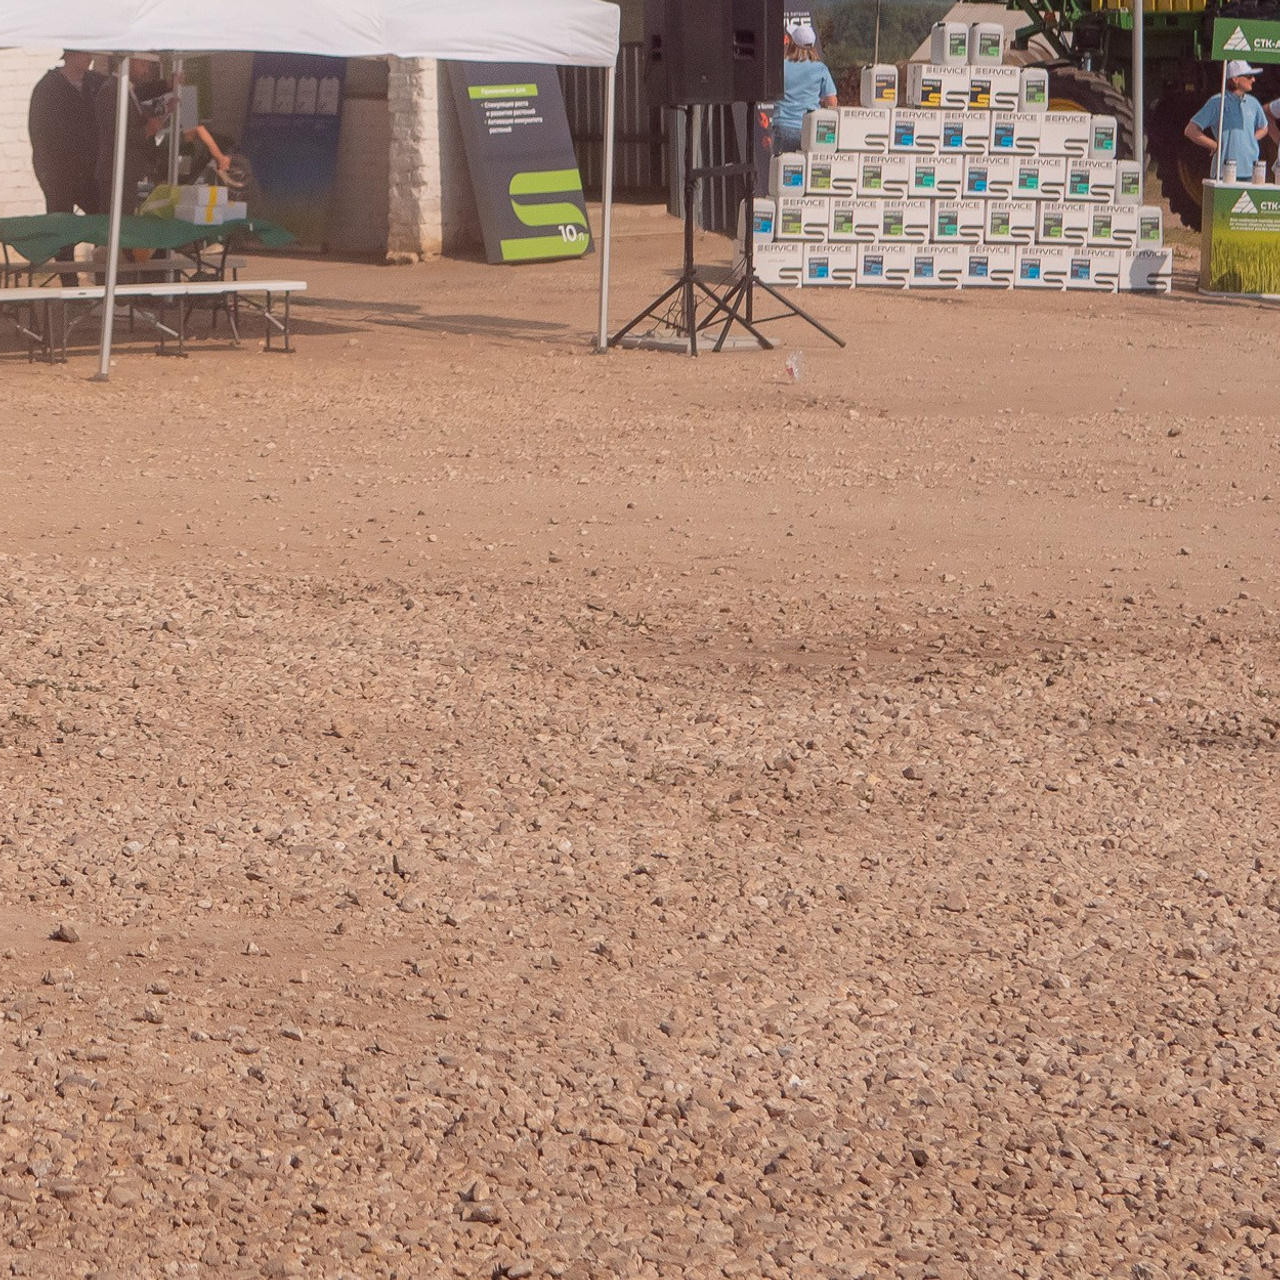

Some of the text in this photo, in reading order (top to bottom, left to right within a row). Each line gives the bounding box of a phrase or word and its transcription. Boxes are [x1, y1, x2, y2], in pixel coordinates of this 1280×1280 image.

[926, 66, 967, 74] SERVICE
[975, 67, 1016, 76] SERVICE
[844, 110, 886, 118] SERVICE
[896, 111, 937, 119] SERVICE
[945, 112, 986, 120] SERVICE
[996, 113, 1037, 121] SERVICE
[991, 202, 1032, 210] SERVICE
[1045, 203, 1085, 211] SERVICE
[1094, 205, 1134, 213] SERVICE
[757, 244, 798, 252] SERVICE
[864, 245, 906, 253] SERVICE
[917, 246, 958, 254] SERVICE
[969, 245, 1010, 253] SERVICE
[1074, 248, 1115, 256] SERVICE
